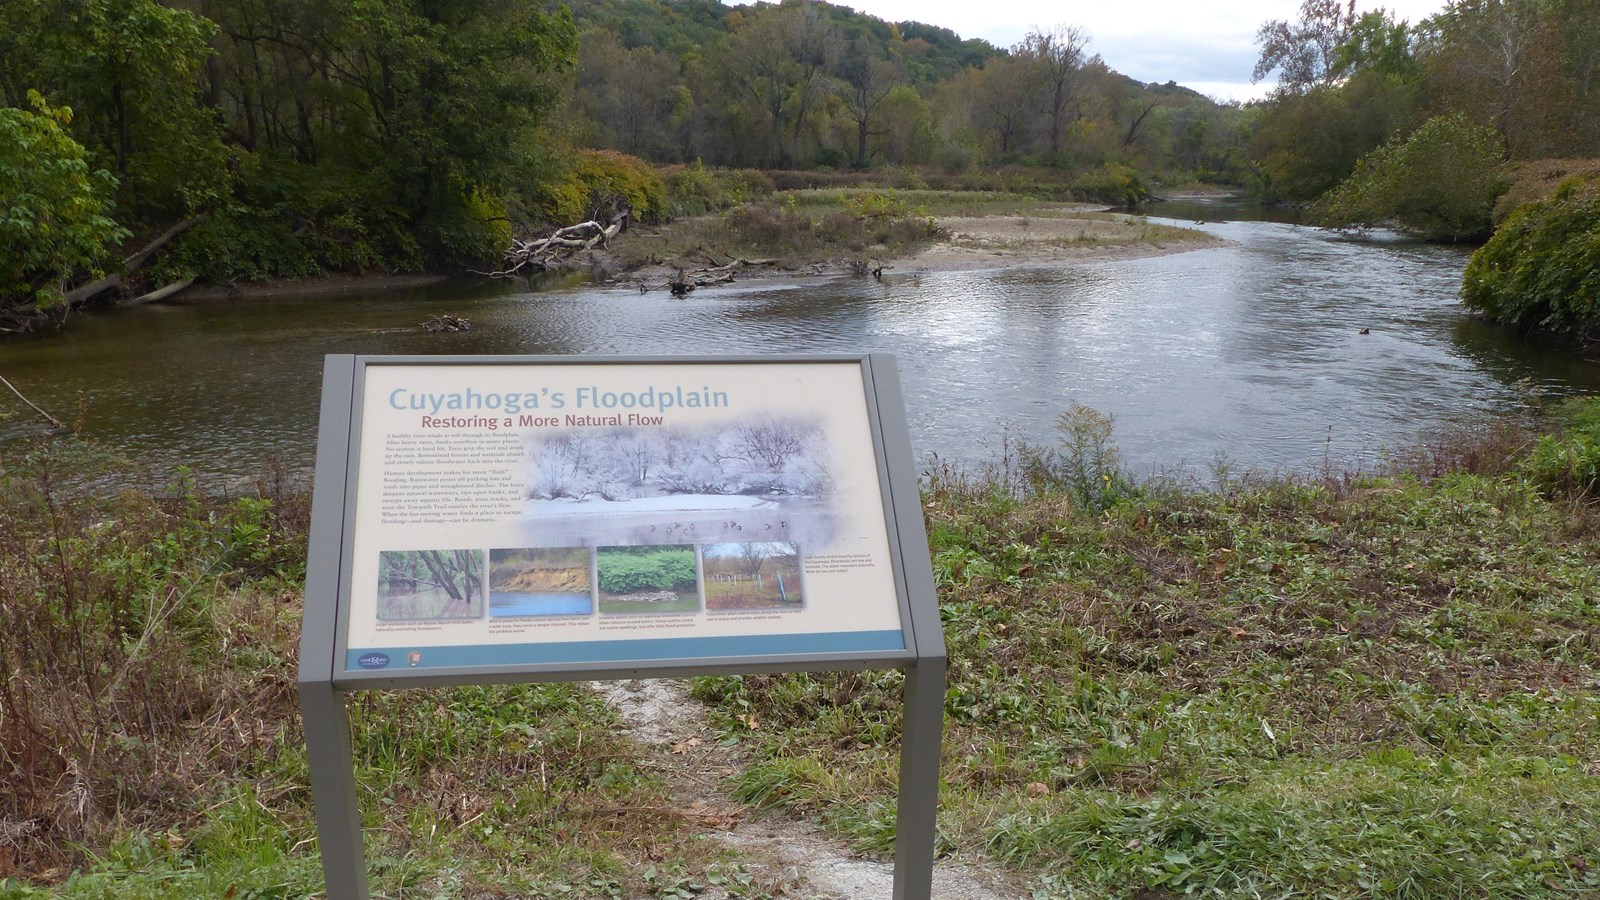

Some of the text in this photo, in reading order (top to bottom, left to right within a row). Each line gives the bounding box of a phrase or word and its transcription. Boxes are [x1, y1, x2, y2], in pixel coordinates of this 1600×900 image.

[389, 385, 729, 415] Cuyahoga’s Floodplain
[421, 413, 664, 430] Restoring a More Natural Flow
